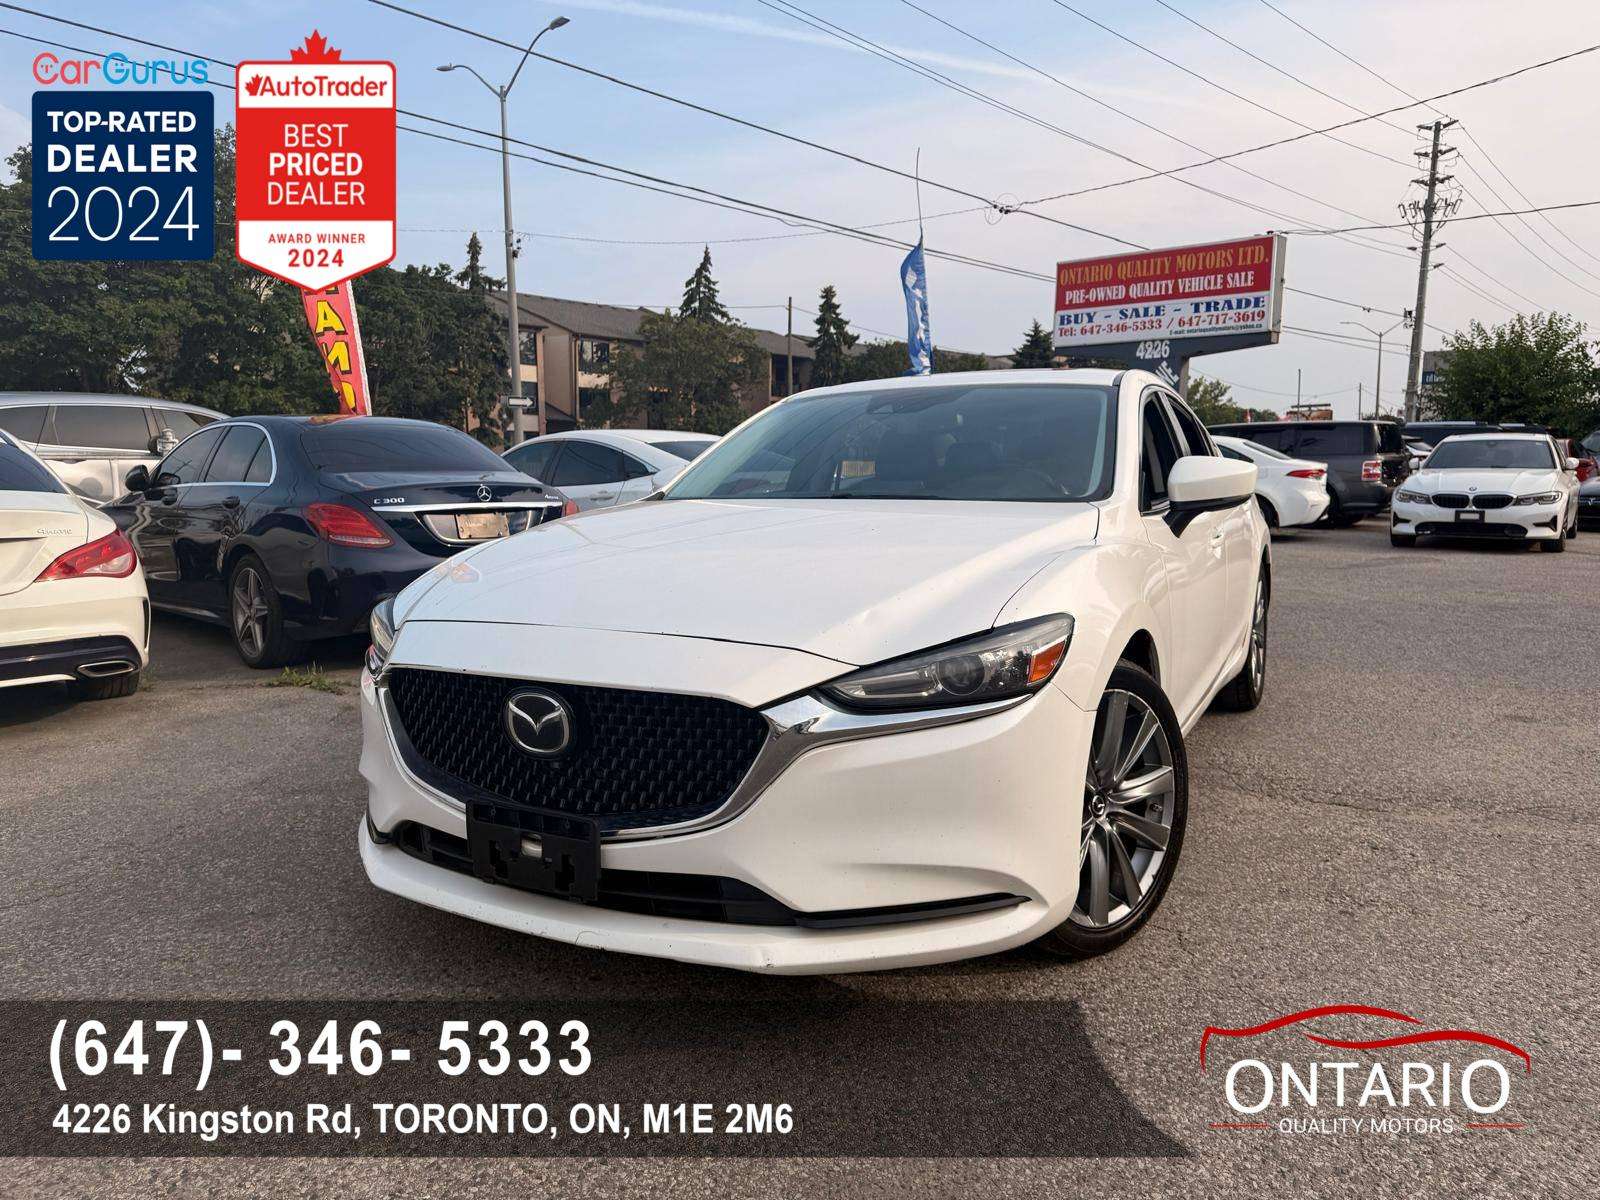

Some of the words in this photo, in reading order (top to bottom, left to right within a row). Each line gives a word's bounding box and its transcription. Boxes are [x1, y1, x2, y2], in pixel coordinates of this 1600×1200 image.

[1060, 263, 1113, 286] ONTARIO
[1117, 256, 1171, 280] QUALITY
[1176, 248, 1233, 273] MOTORS
[1237, 245, 1269, 266] LTD.
[1065, 284, 1126, 305] PRE-OWNED
[1129, 280, 1174, 299] QUALITY
[1178, 273, 1224, 293] VEHICLE
[1226, 270, 1255, 288] SALE
[1058, 326, 1077, 337] Tel:
[1080, 318, 1162, 336] 647-346-5333
[1178, 309, 1265, 328] 647-717-3619
[1059, 311, 1097, 326] BUY
[1119, 305, 1165, 320] SALE
[1190, 296, 1265, 314] TRADE
[1136, 340, 1170, 360] 4226
